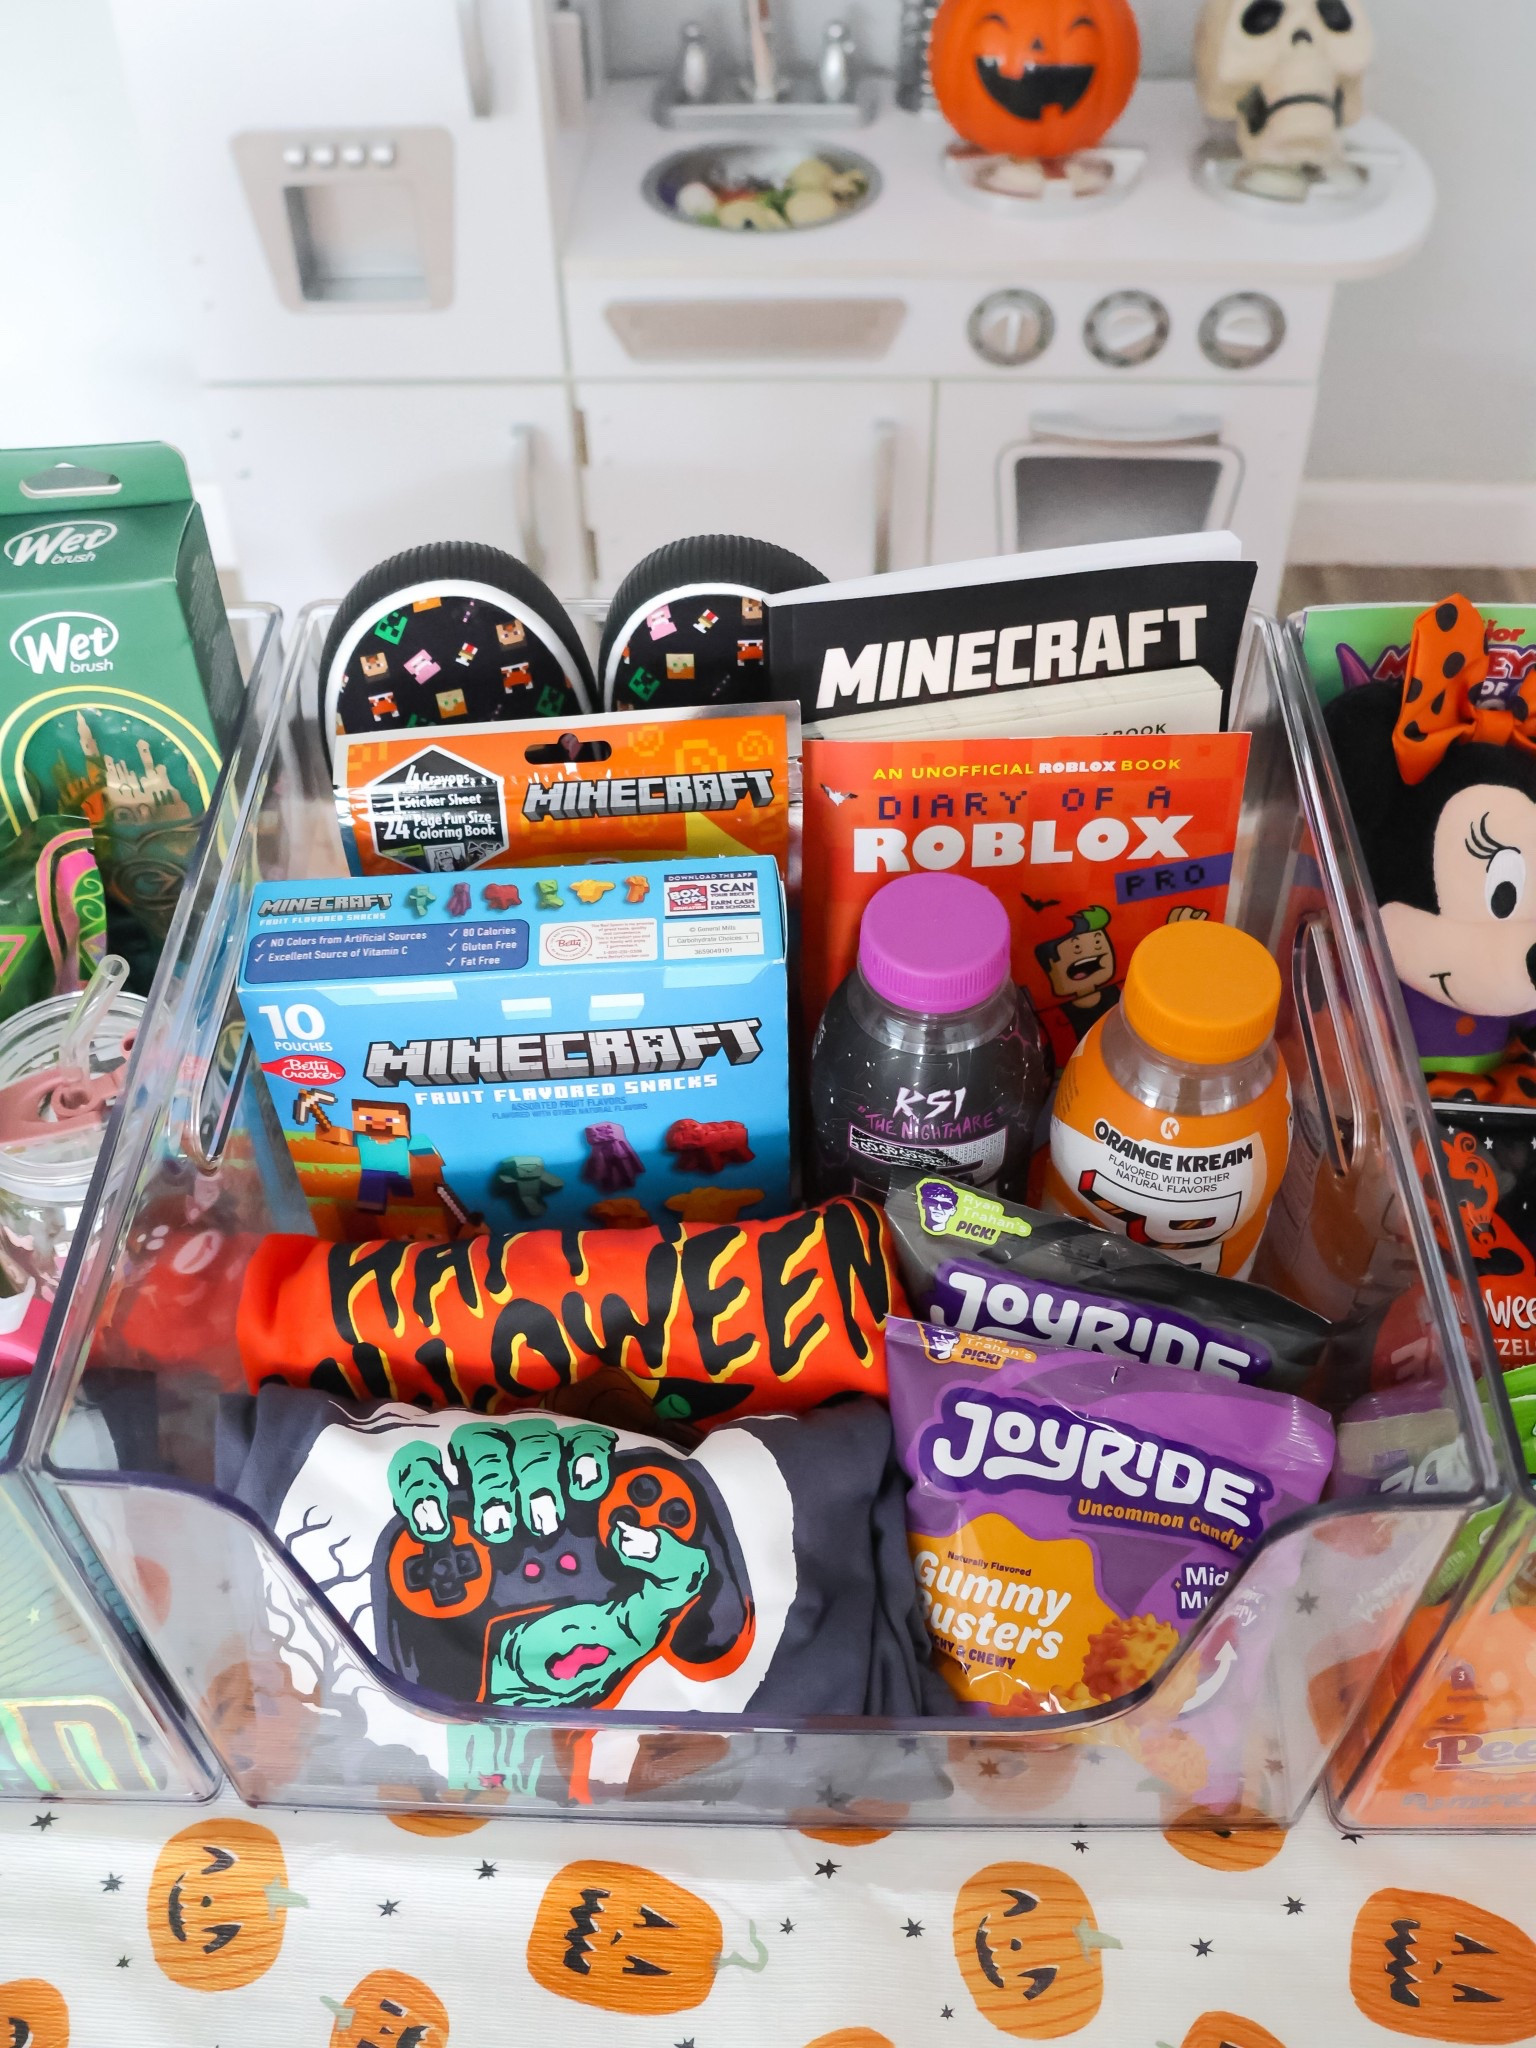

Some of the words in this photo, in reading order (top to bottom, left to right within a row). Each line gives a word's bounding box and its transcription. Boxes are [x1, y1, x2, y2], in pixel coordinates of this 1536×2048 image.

[13, 527, 107, 567] Wet
[51, 550, 97, 565] brush
[23, 622, 109, 675] Wet
[816, 604, 1207, 710] MINECRAFT
[70, 659, 114, 674] brush
[873, 768, 903, 780] AN
[911, 763, 1035, 780] UNOFFICIAL
[1039, 760, 1117, 775] ROBLOX
[1121, 759, 1181, 772] BOOK
[404, 795, 446, 809] Sticker
[448, 793, 481, 806] Sheet
[521, 769, 777, 823] MINECRAFT
[878, 790, 1028, 820] DIARY
[1062, 787, 1114, 812] OF
[1148, 786, 1172, 809] A
[414, 812, 442, 829] Page
[443, 811, 466, 824] Fun
[467, 810, 492, 824] Size
[413, 826, 463, 841] Coloring
[464, 824, 496, 837] Book
[853, 815, 1194, 873] ROBLOX
[668, 874, 718, 882] DOWNLOAD
[710, 882, 754, 893] SCAN
[1125, 866, 1206, 898] PRO
[669, 887, 702, 900] BOX
[674, 895, 708, 906] TOPS
[257, 894, 393, 917] MINECRAFT
[259, 917, 288, 926] FRUIT
[462, 927, 475, 937] 80
[477, 926, 517, 936] Calories
[270, 938, 283, 948] NO
[286, 936, 317, 947] Colors
[319, 935, 342, 945] from
[344, 933, 386, 943] Artificial
[388, 931, 427, 942] Sources
[461, 942, 493, 952] Gluten
[495, 940, 517, 950] Free
[677, 936, 717, 945] Carbohydrate
[268, 951, 312, 962] Excellent
[314, 949, 348, 960] Source
[350, 948, 361, 958] of
[363, 946, 399, 957] Vitamin
[401, 946, 408, 955] C
[460, 957, 476, 966] Fat
[478, 956, 500, 966] Free
[258, 1003, 326, 1041] 10
[274, 1041, 333, 1052] POUCHES
[362, 1017, 763, 1088] MINECRAFT
[282, 1067, 341, 1080] Crocker
[284, 1059, 329, 1071] Betty
[414, 1090, 483, 1106] FRUIT
[493, 1082, 616, 1102] FLAVORED
[624, 1074, 718, 1095] SNACKS
[492, 1111, 531, 1119] FLAVORED
[532, 1110, 551, 1118] WITH
[552, 1108, 577, 1117] OTHER
[614, 1103, 648, 1112] FLAVORS
[511, 1100, 557, 1111] ASSORTED
[560, 1099, 584, 1108] FRUIT
[587, 1096, 627, 1107] FLAVORS
[893, 1086, 967, 1123] KSI
[1095, 1120, 1173, 1171] ORANGE
[1176, 1143, 1253, 1172] KREAM
[1108, 1154, 1158, 1181] FLAVORED
[1162, 1174, 1190, 1185] WITH
[1193, 1172, 1230, 1185] OTHER
[1115, 1169, 1163, 1191] NATURAL
[1166, 1184, 1218, 1194] FLAVORS
[963, 1194, 1001, 1213] Ryan
[955, 1220, 996, 1241] PICK!
[963, 1206, 1028, 1234] Trahan's
[966, 1338, 1033, 1361] Trahan's
[1077, 1498, 1184, 1529] Uncommon
[1189, 1516, 1244, 1551] Candy
[947, 1551, 989, 1570] Naturally
[990, 1562, 1032, 1577] Flavored
[914, 1551, 1072, 1628] Gummy
[969, 1649, 1016, 1670] CHEWY
